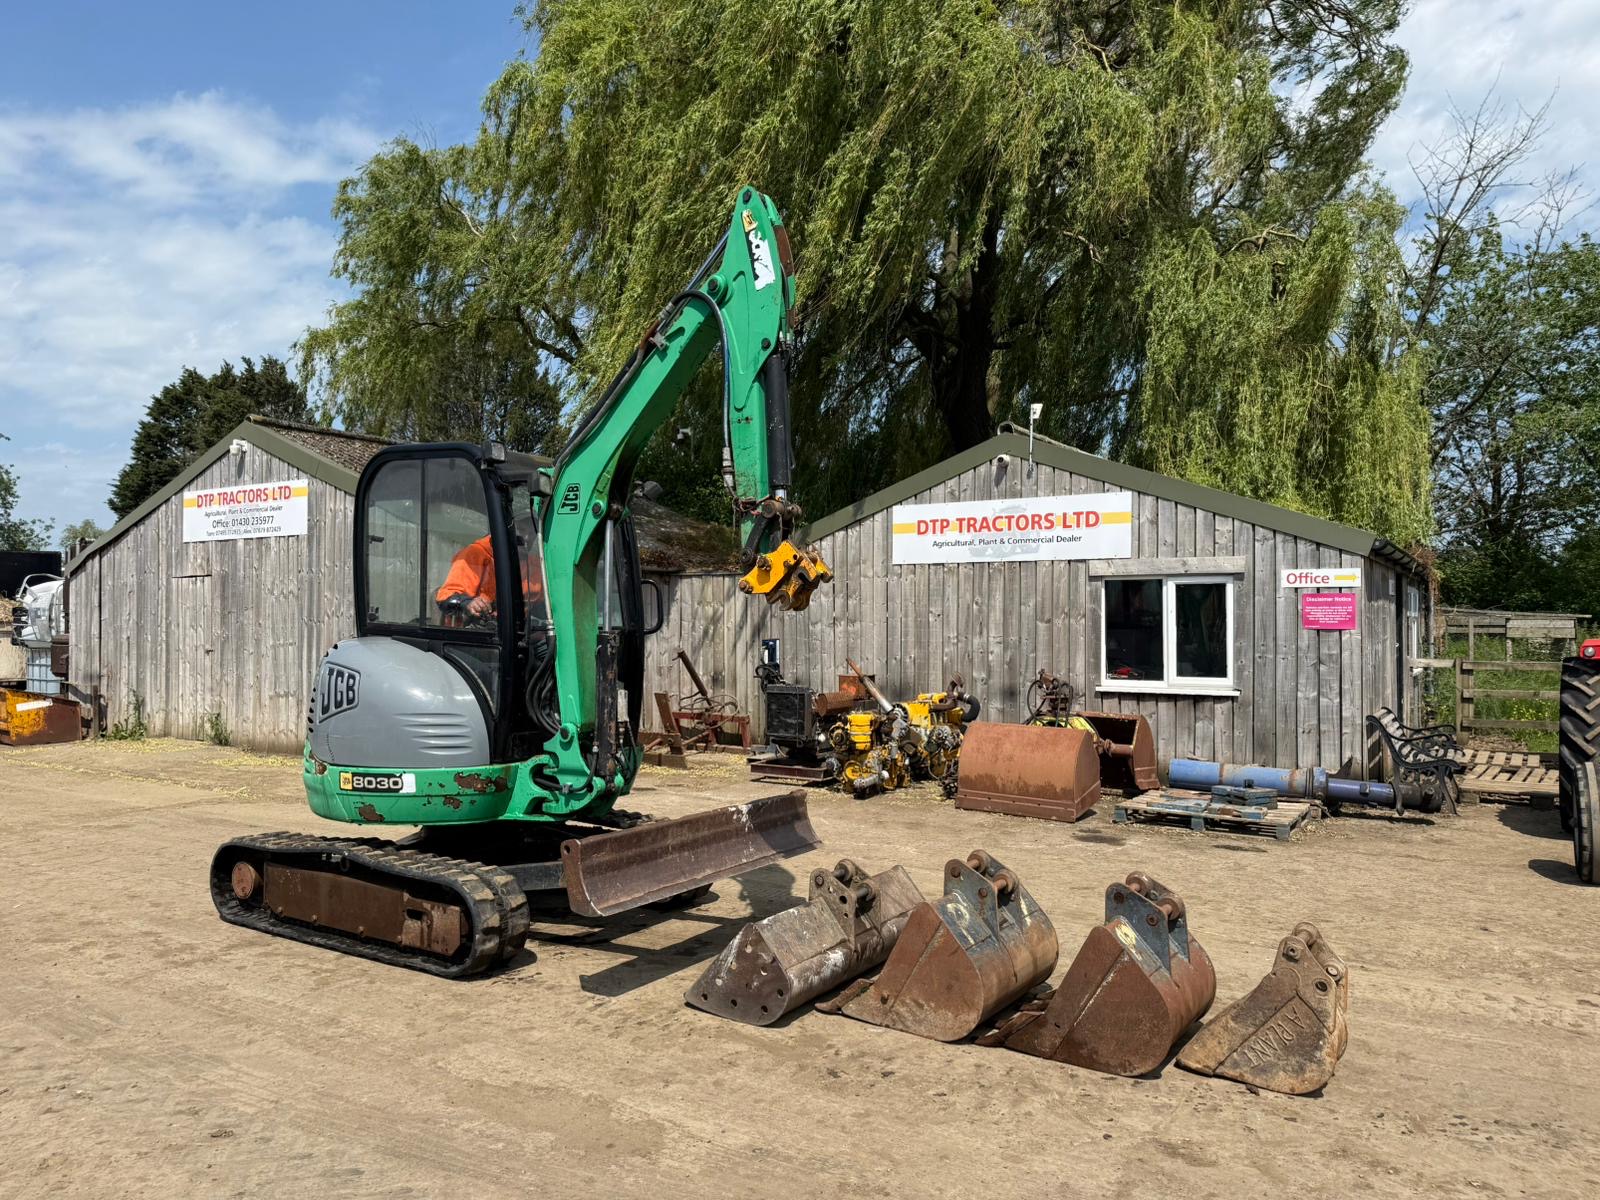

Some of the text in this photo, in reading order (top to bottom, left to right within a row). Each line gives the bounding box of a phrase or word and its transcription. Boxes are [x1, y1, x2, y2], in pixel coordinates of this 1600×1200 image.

[197, 485, 291, 508] DTP TRACTORS LTD
[561, 486, 579, 511] JCB
[212, 515, 274, 528] Office: 01430 235977
[916, 510, 1100, 535] DTP TRACTORS LTD
[932, 534, 1082, 549] Agricultural, Plant & Commercial Dealer
[1286, 572, 1330, 584] Office
[321, 667, 356, 716] JCB
[353, 776, 402, 789] 8030
[1243, 1021, 1296, 1069] PLANT
